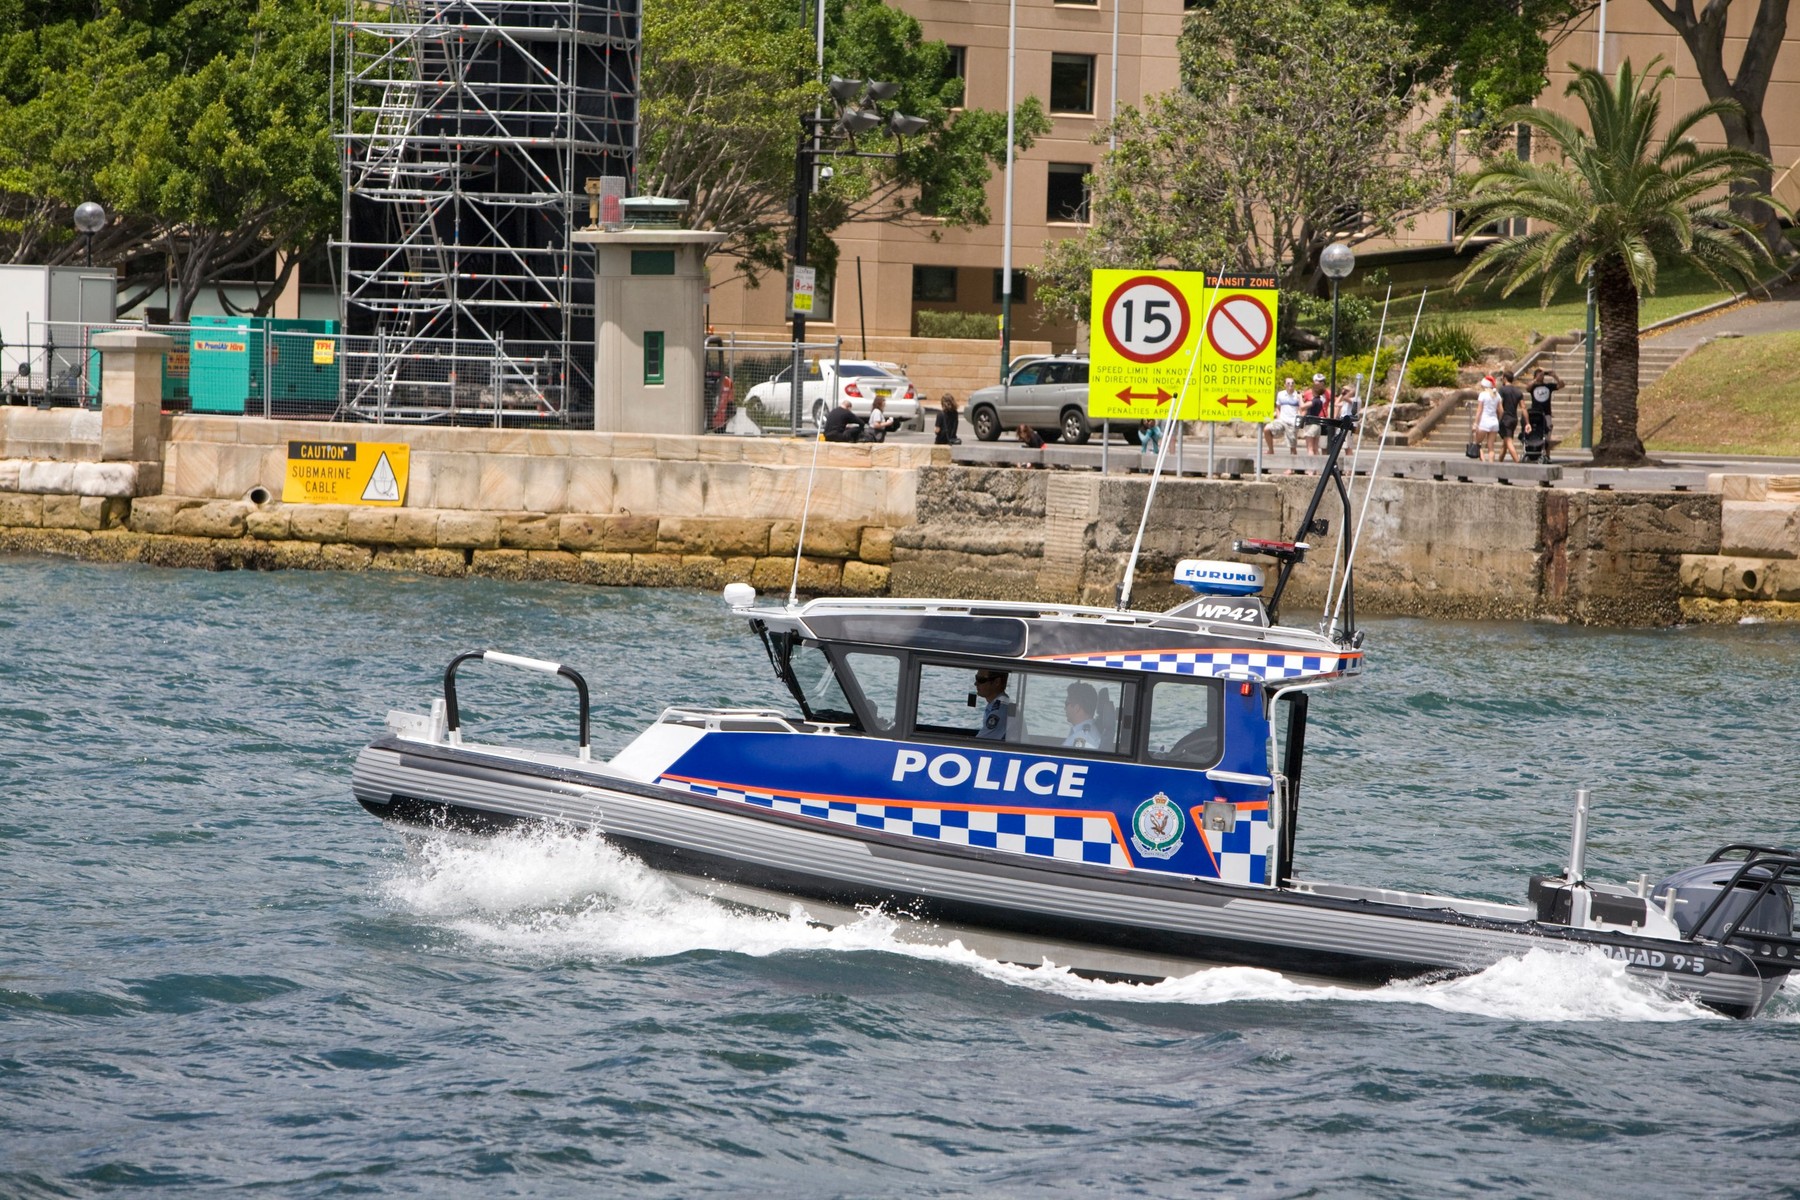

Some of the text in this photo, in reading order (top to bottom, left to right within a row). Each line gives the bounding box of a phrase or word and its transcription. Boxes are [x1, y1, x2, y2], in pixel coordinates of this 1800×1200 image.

[1206, 276, 1275, 287] TRANSIT ZONE
[1122, 299, 1172, 344] 15
[1096, 365, 1123, 374] SPEED
[1127, 366, 1149, 375] LIMIT
[1203, 363, 1273, 375] NO STOPPING
[1092, 375, 1101, 383] IN
[1104, 375, 1149, 384] DIRECTION
[1203, 375, 1272, 386] OR DRIFTING
[1106, 406, 1150, 415] PENALTIES
[1201, 408, 1243, 417] PENALTIES
[300, 444, 345, 459] CAUTION
[291, 465, 352, 480] SUBMARINE
[305, 480, 337, 494] CABLE
[1185, 569, 1257, 582] FURUNO
[1195, 603, 1259, 623] WP42
[891, 749, 1089, 798] POLICE
